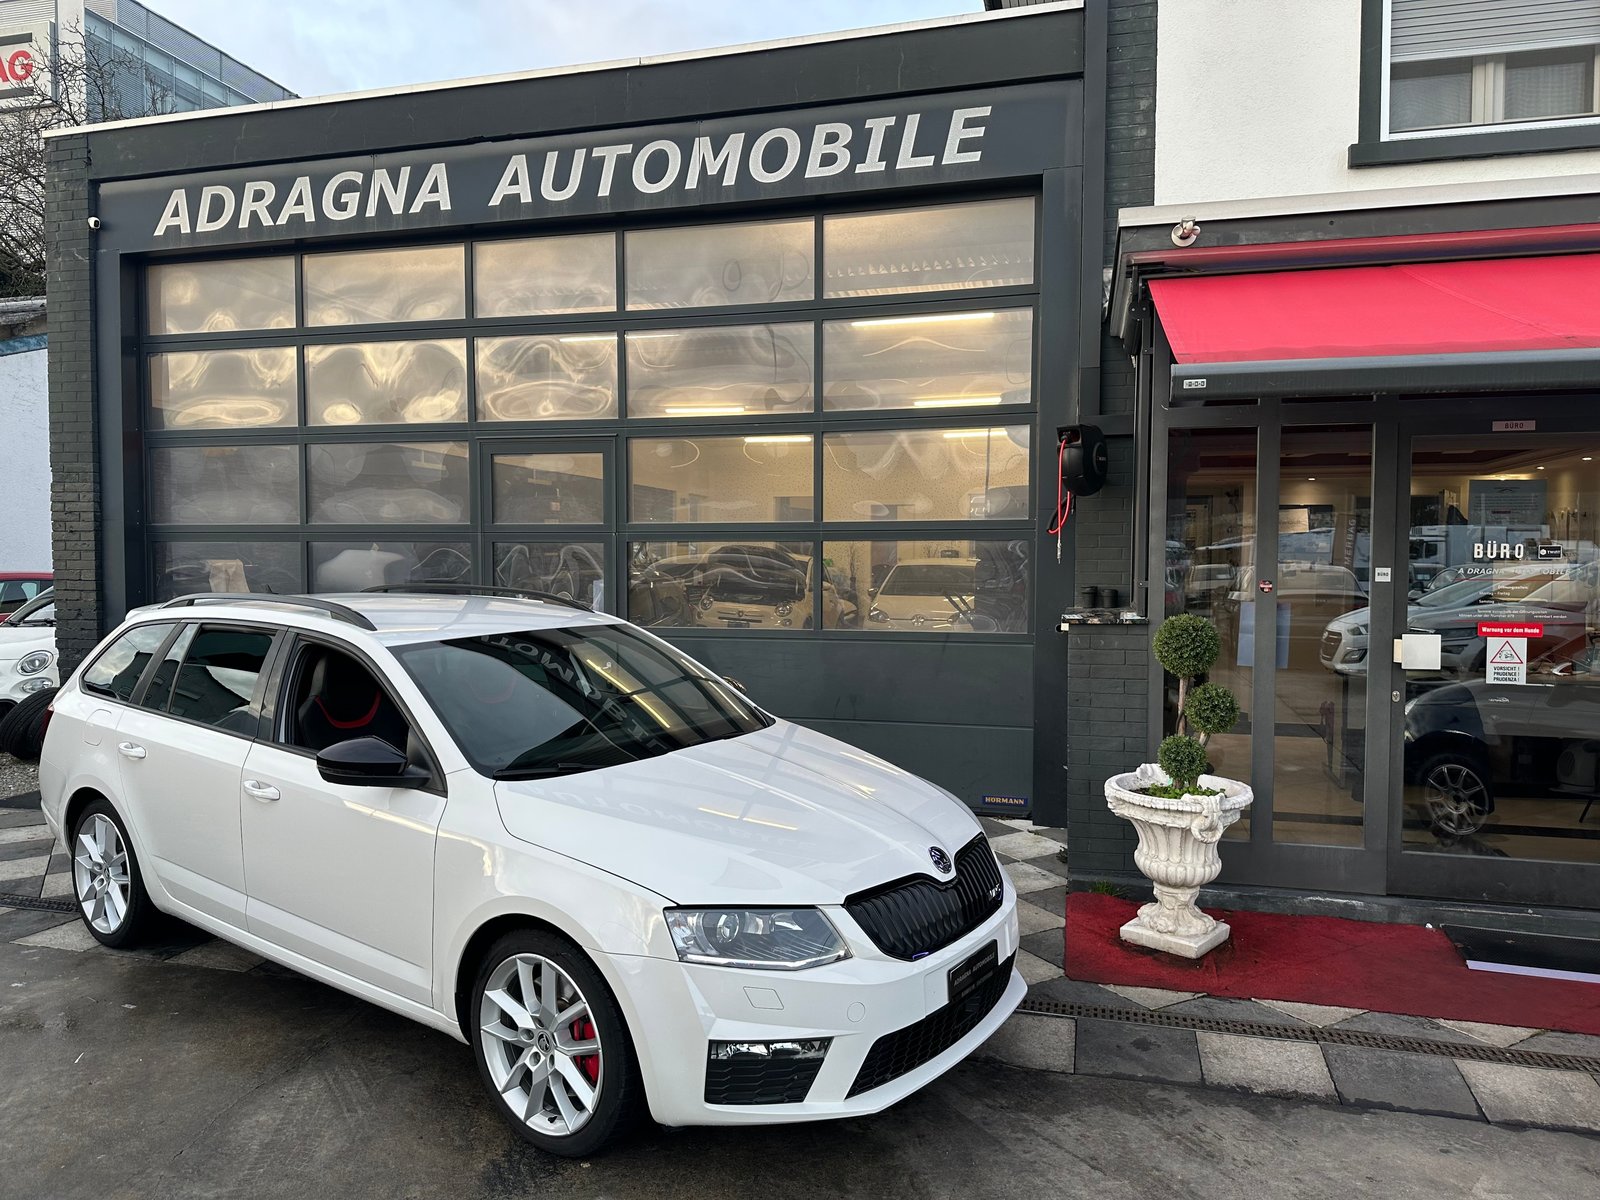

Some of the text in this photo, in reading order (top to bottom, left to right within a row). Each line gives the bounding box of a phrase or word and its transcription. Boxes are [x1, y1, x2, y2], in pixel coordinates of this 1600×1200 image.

[153, 105, 993, 236] ADRAGNA AUTOMOBILE
[1474, 541, 1524, 559] BÜRO
[1481, 626, 1503, 634] Warnung
